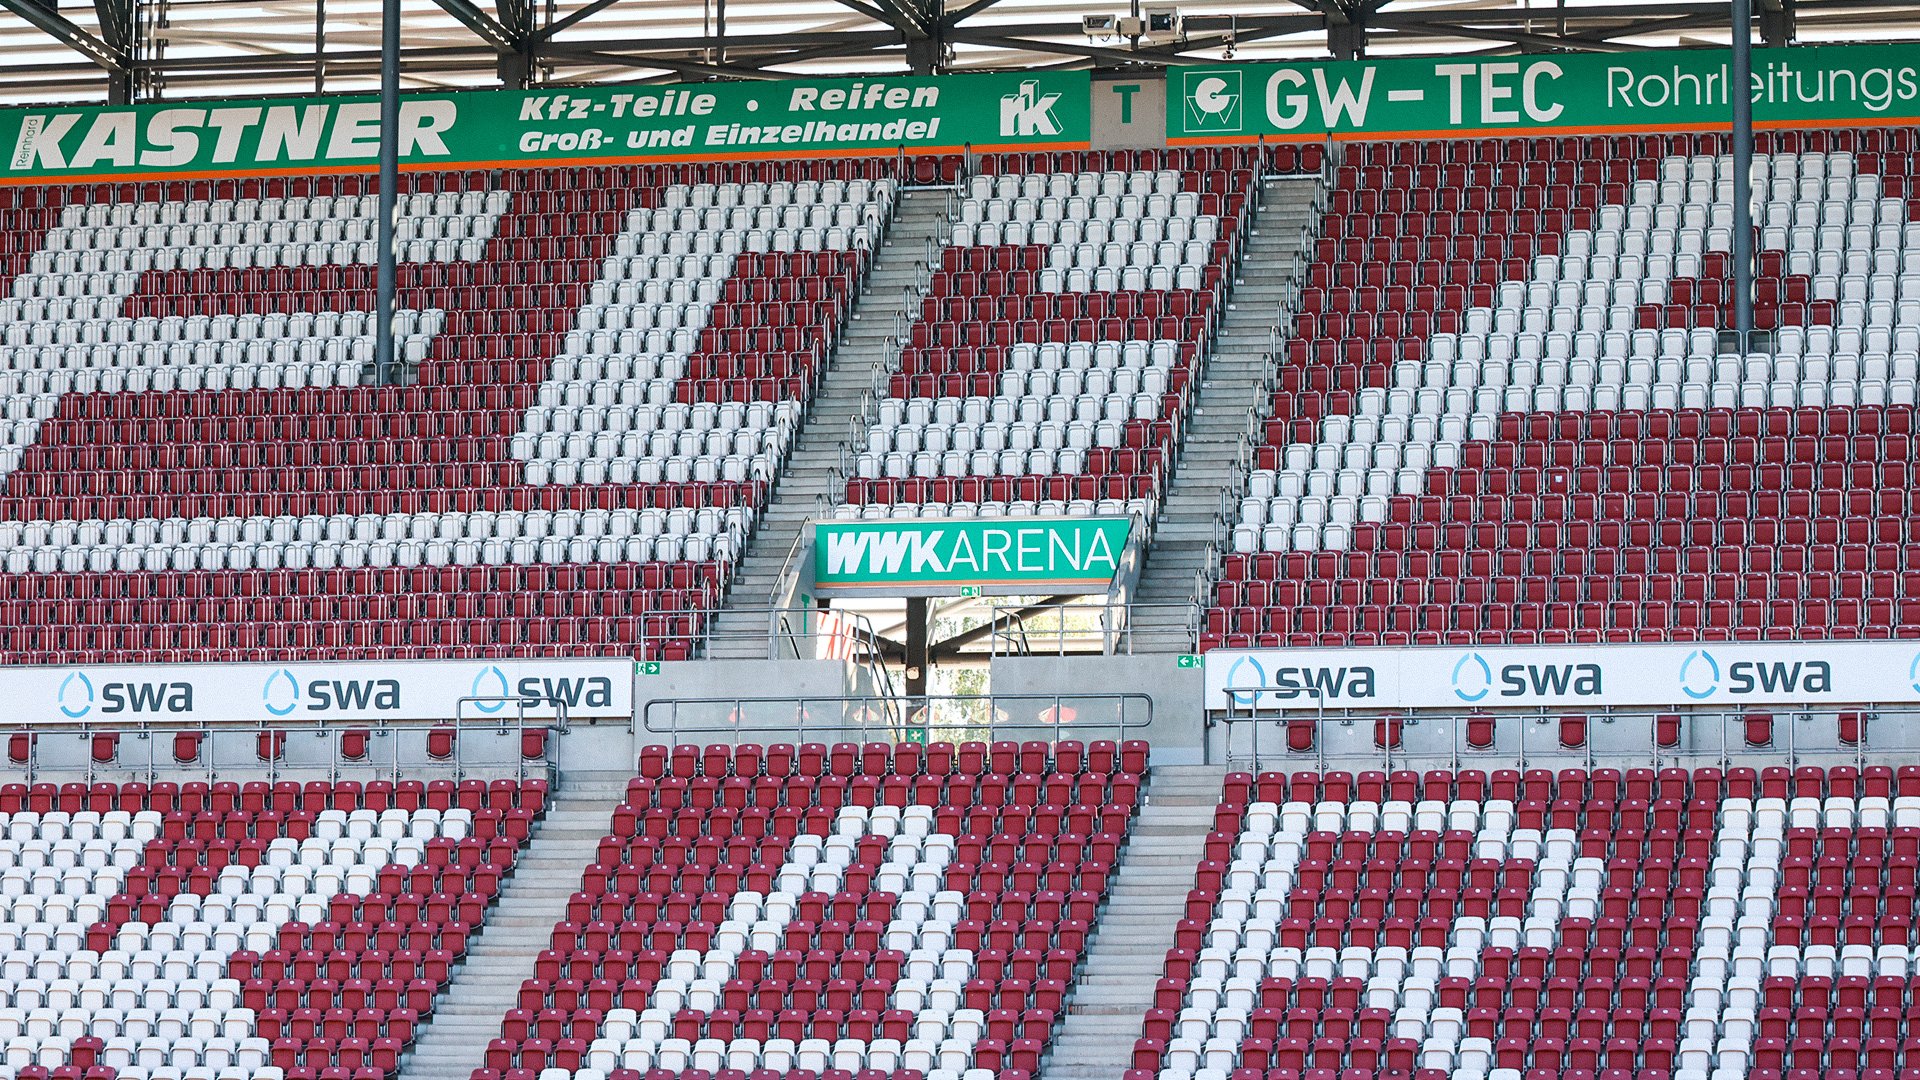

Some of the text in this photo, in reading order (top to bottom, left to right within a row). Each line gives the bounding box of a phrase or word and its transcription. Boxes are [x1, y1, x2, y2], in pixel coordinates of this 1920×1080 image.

[518, 83, 939, 121] Kfz-Teile Reifen
[1112, 84, 1141, 124] T
[10, 100, 457, 170] KASTNER
[15, 118, 38, 167] Reinhard
[518, 117, 940, 153] Groß- und Einzelhandel
[306, 677, 401, 711] swa
[516, 676, 612, 709] swa
[1274, 666, 1376, 699] swa
[1499, 660, 1603, 697] swa
[1728, 659, 1832, 694] swa
[101, 678, 194, 713] swa
